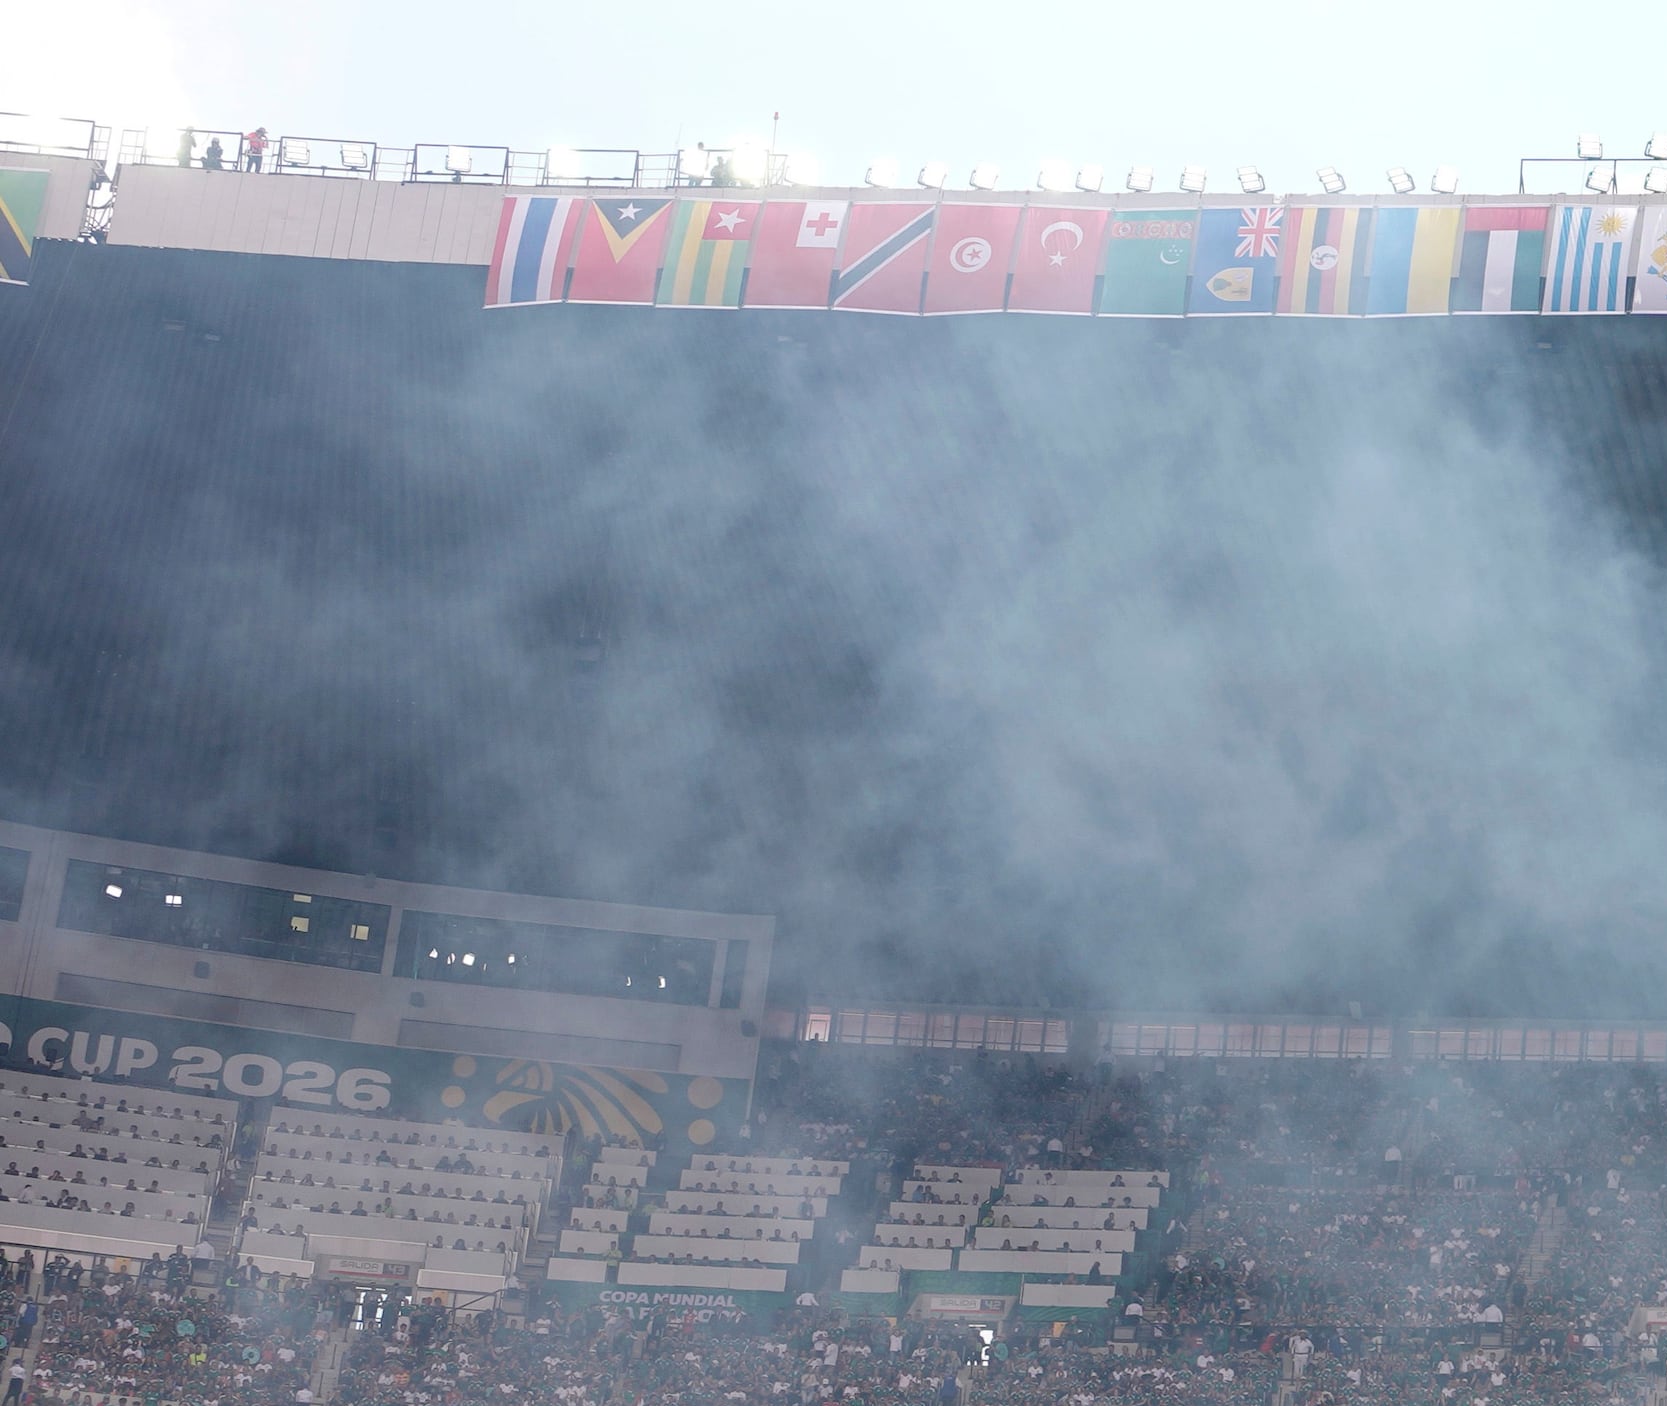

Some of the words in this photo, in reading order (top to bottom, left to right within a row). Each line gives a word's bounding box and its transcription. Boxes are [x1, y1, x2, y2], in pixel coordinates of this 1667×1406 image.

[27, 1026, 159, 1077] CUP
[168, 1045, 391, 1111] 2026
[341, 1260, 379, 1271] SALIDA
[387, 1264, 406, 1276] 43
[600, 1291, 651, 1306] COPA
[656, 1292, 737, 1308] MUNDIAL
